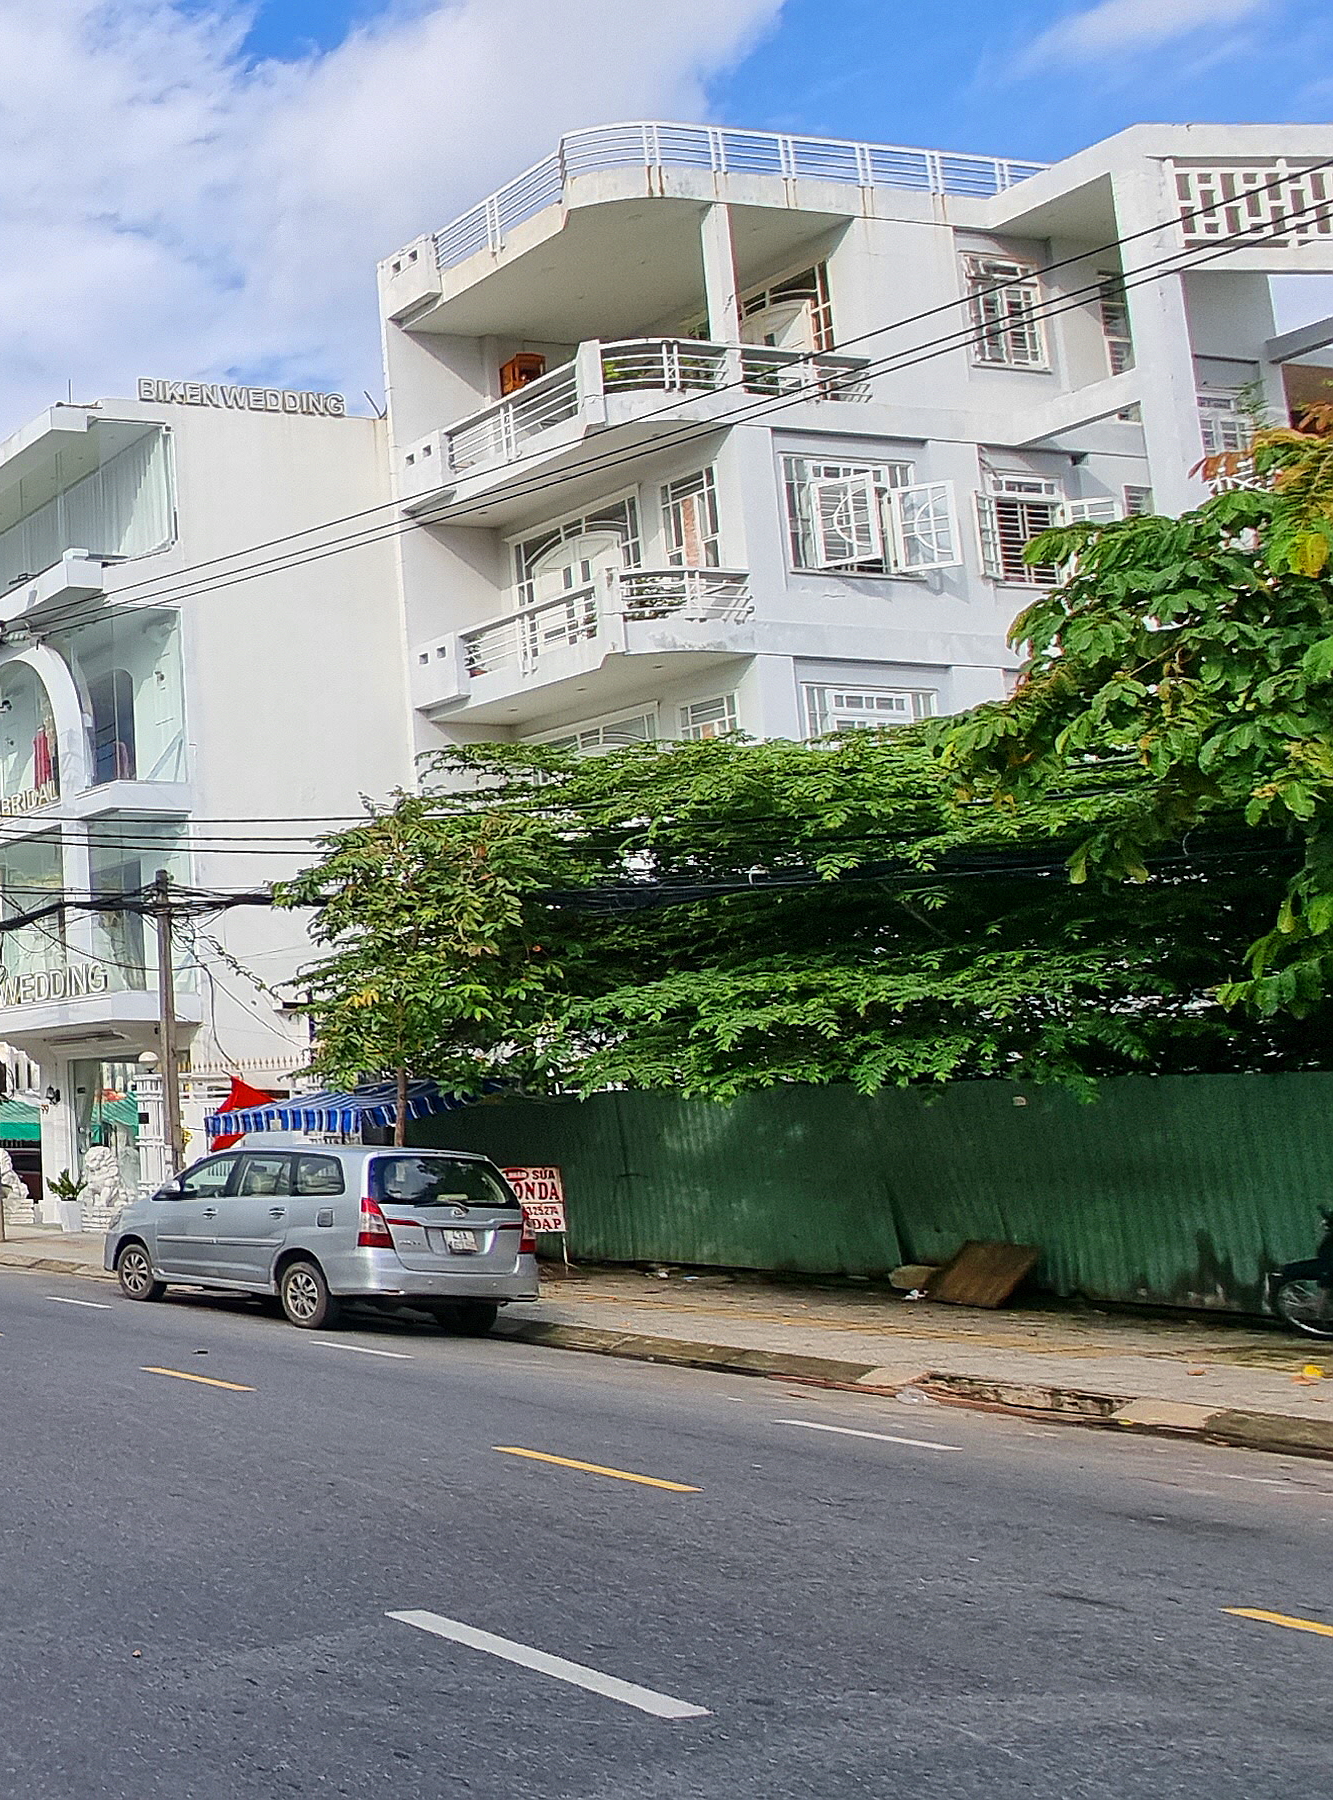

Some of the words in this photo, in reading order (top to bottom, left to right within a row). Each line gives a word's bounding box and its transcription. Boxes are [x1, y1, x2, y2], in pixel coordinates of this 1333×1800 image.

[138, 378, 221, 408] BIKEN
[220, 385, 345, 416] WEDDING
[514, 1182, 559, 1200] ONDA
